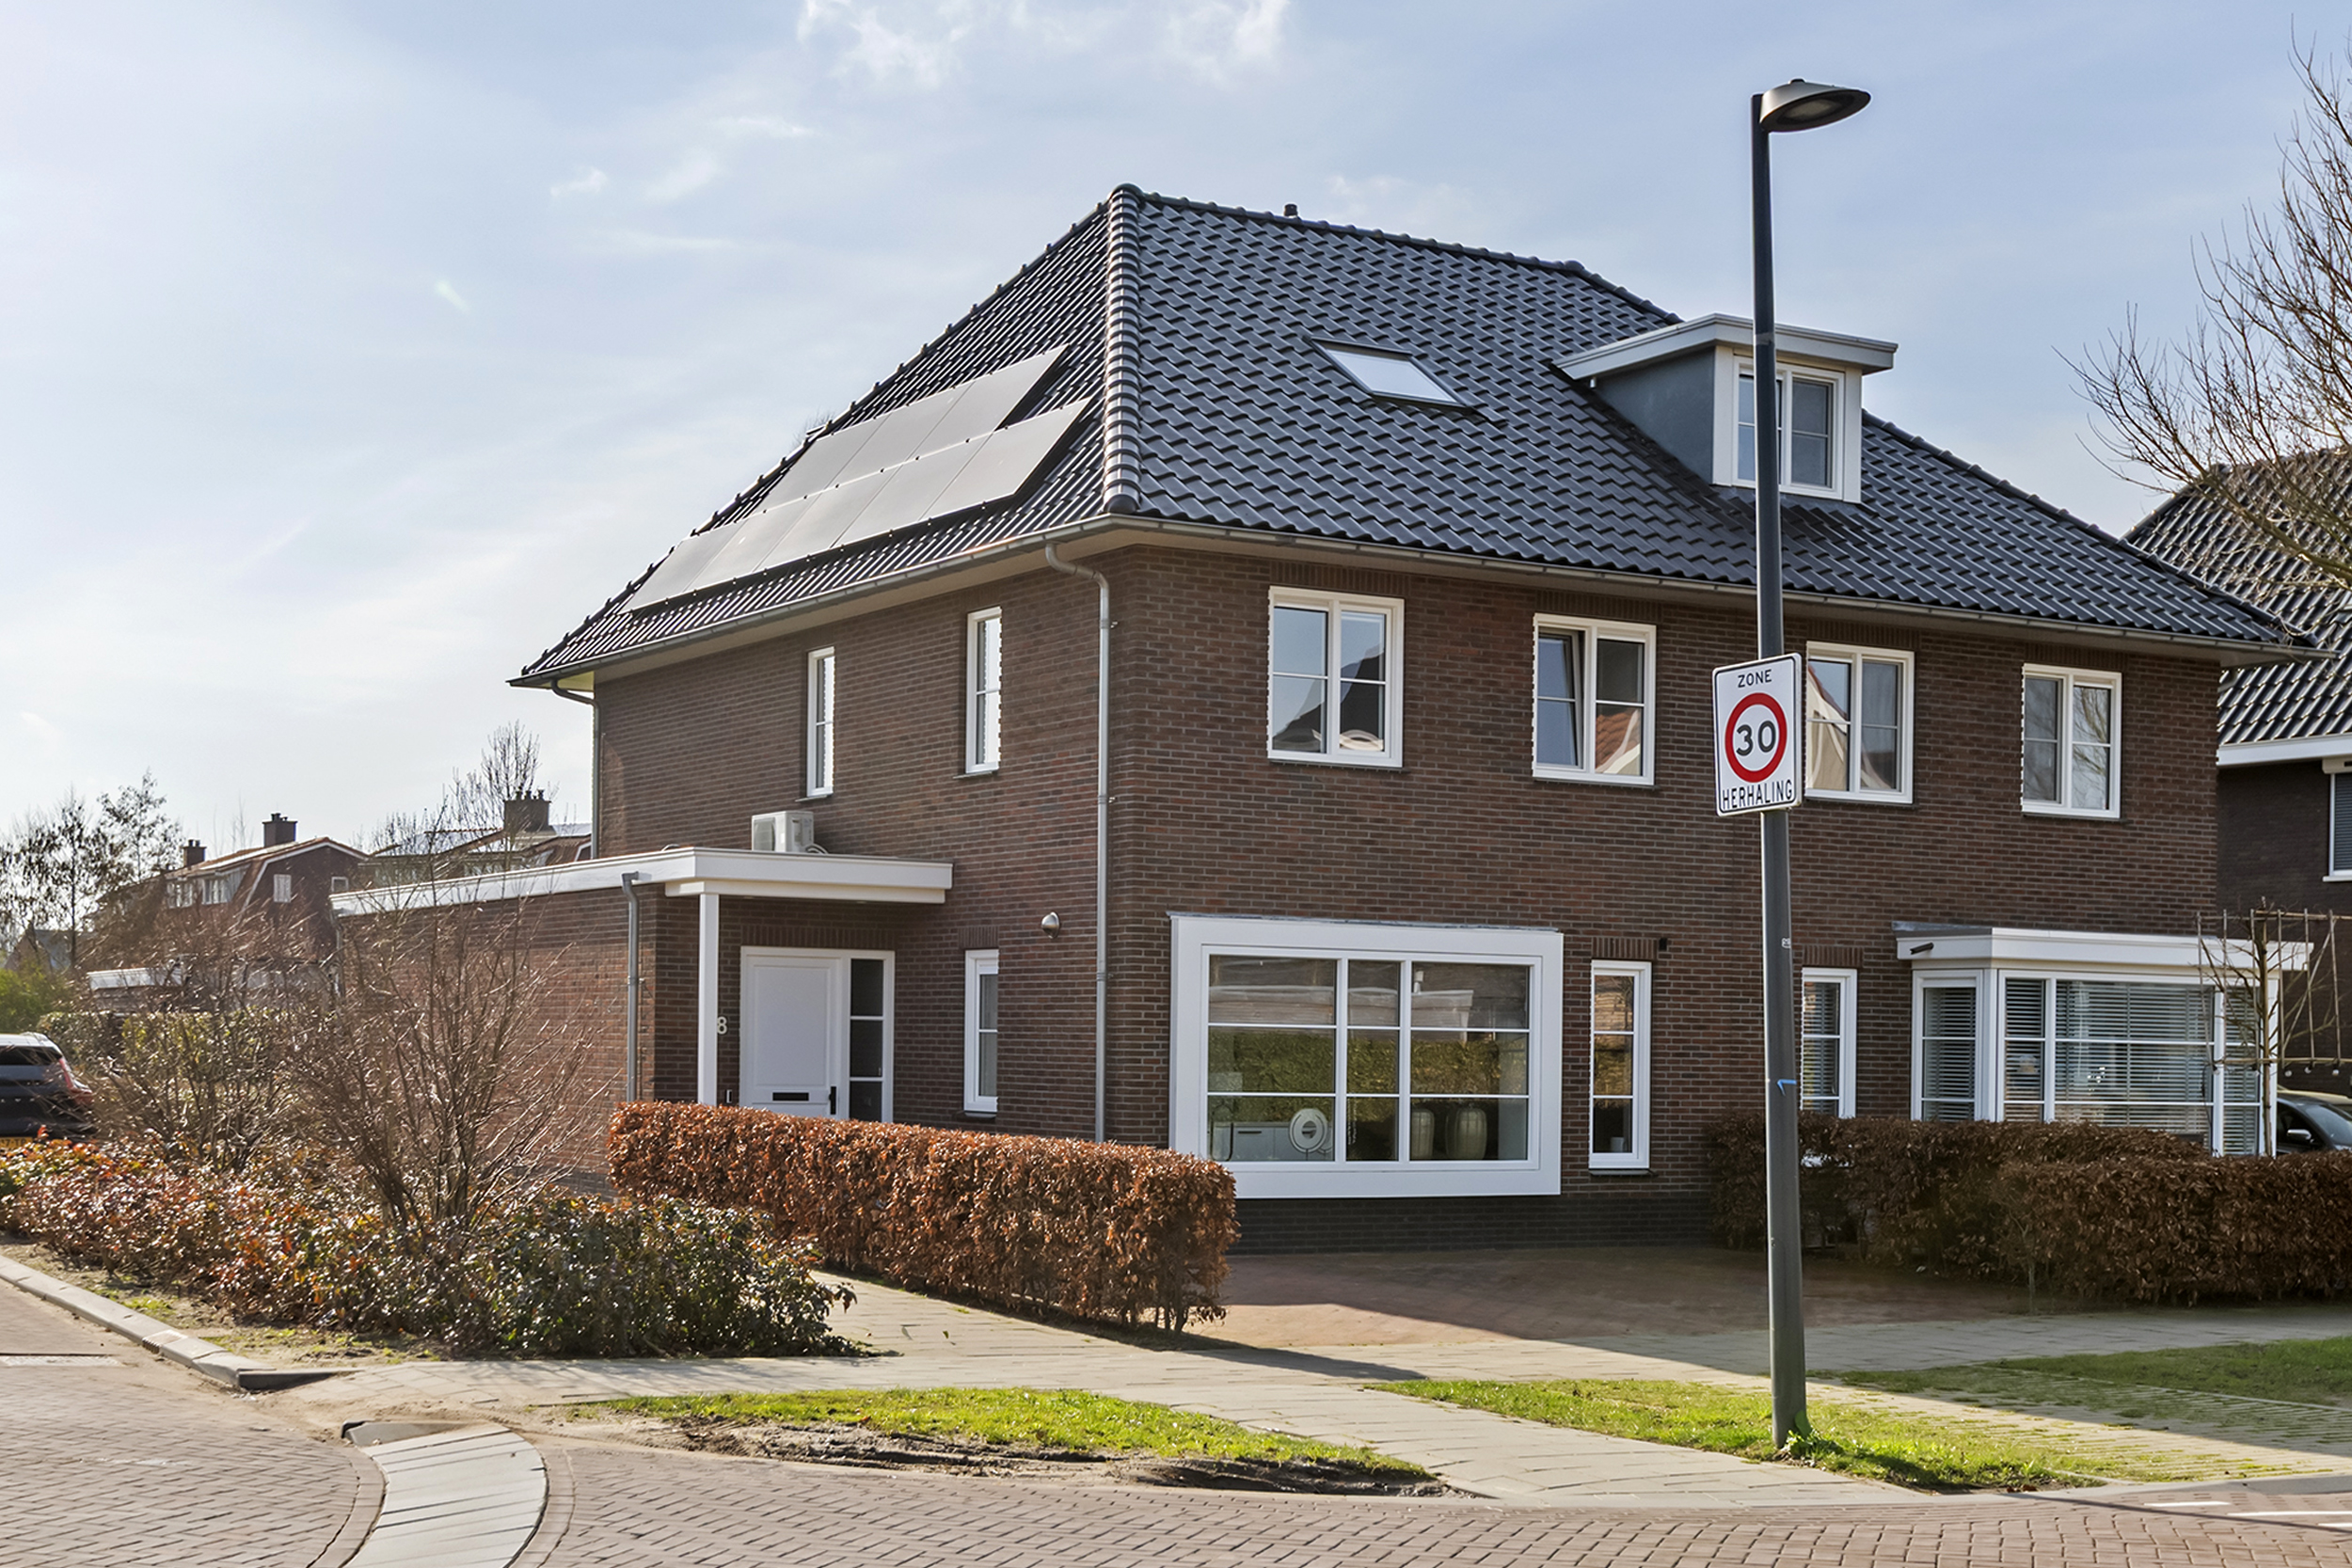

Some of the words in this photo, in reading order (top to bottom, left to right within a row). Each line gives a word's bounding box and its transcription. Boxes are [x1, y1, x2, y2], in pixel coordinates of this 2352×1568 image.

[1738, 669, 1772, 688] ZONE
[1736, 720, 1776, 756] 30
[1722, 779, 1792, 810] HERHALING
[717, 1016, 727, 1035] 8
